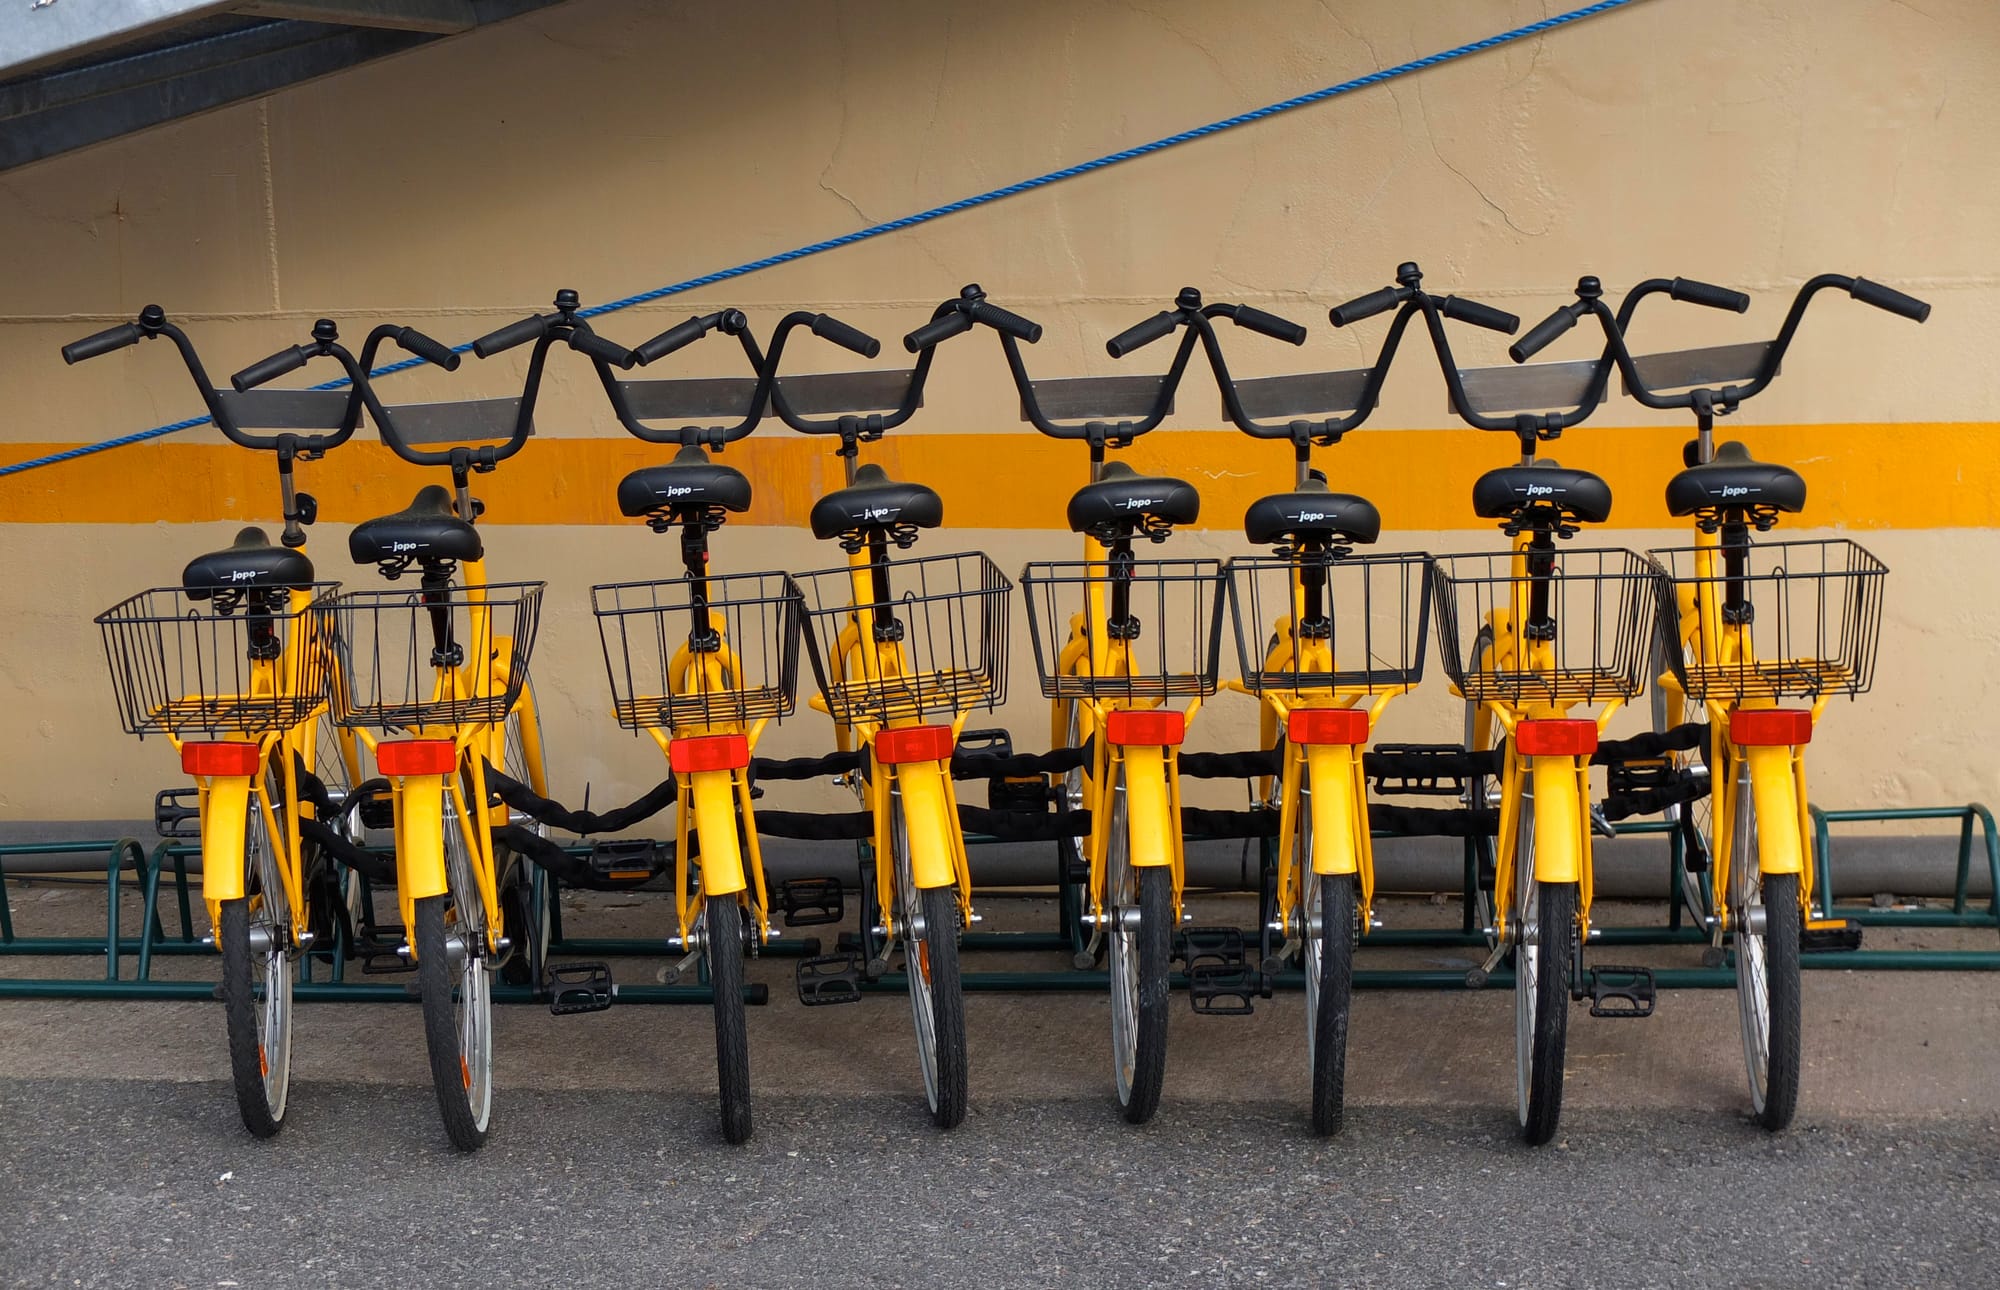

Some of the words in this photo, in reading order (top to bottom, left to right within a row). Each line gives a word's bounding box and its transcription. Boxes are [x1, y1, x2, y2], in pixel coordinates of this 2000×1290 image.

[667, 485, 691, 497] jopo
[1527, 484, 1552, 495] jopo
[1722, 485, 1748, 497] jopo
[1127, 498, 1151, 509] jopo
[1299, 510, 1324, 521] jopo
[393, 541, 416, 552] jopo
[232, 570, 256, 581] jopo
